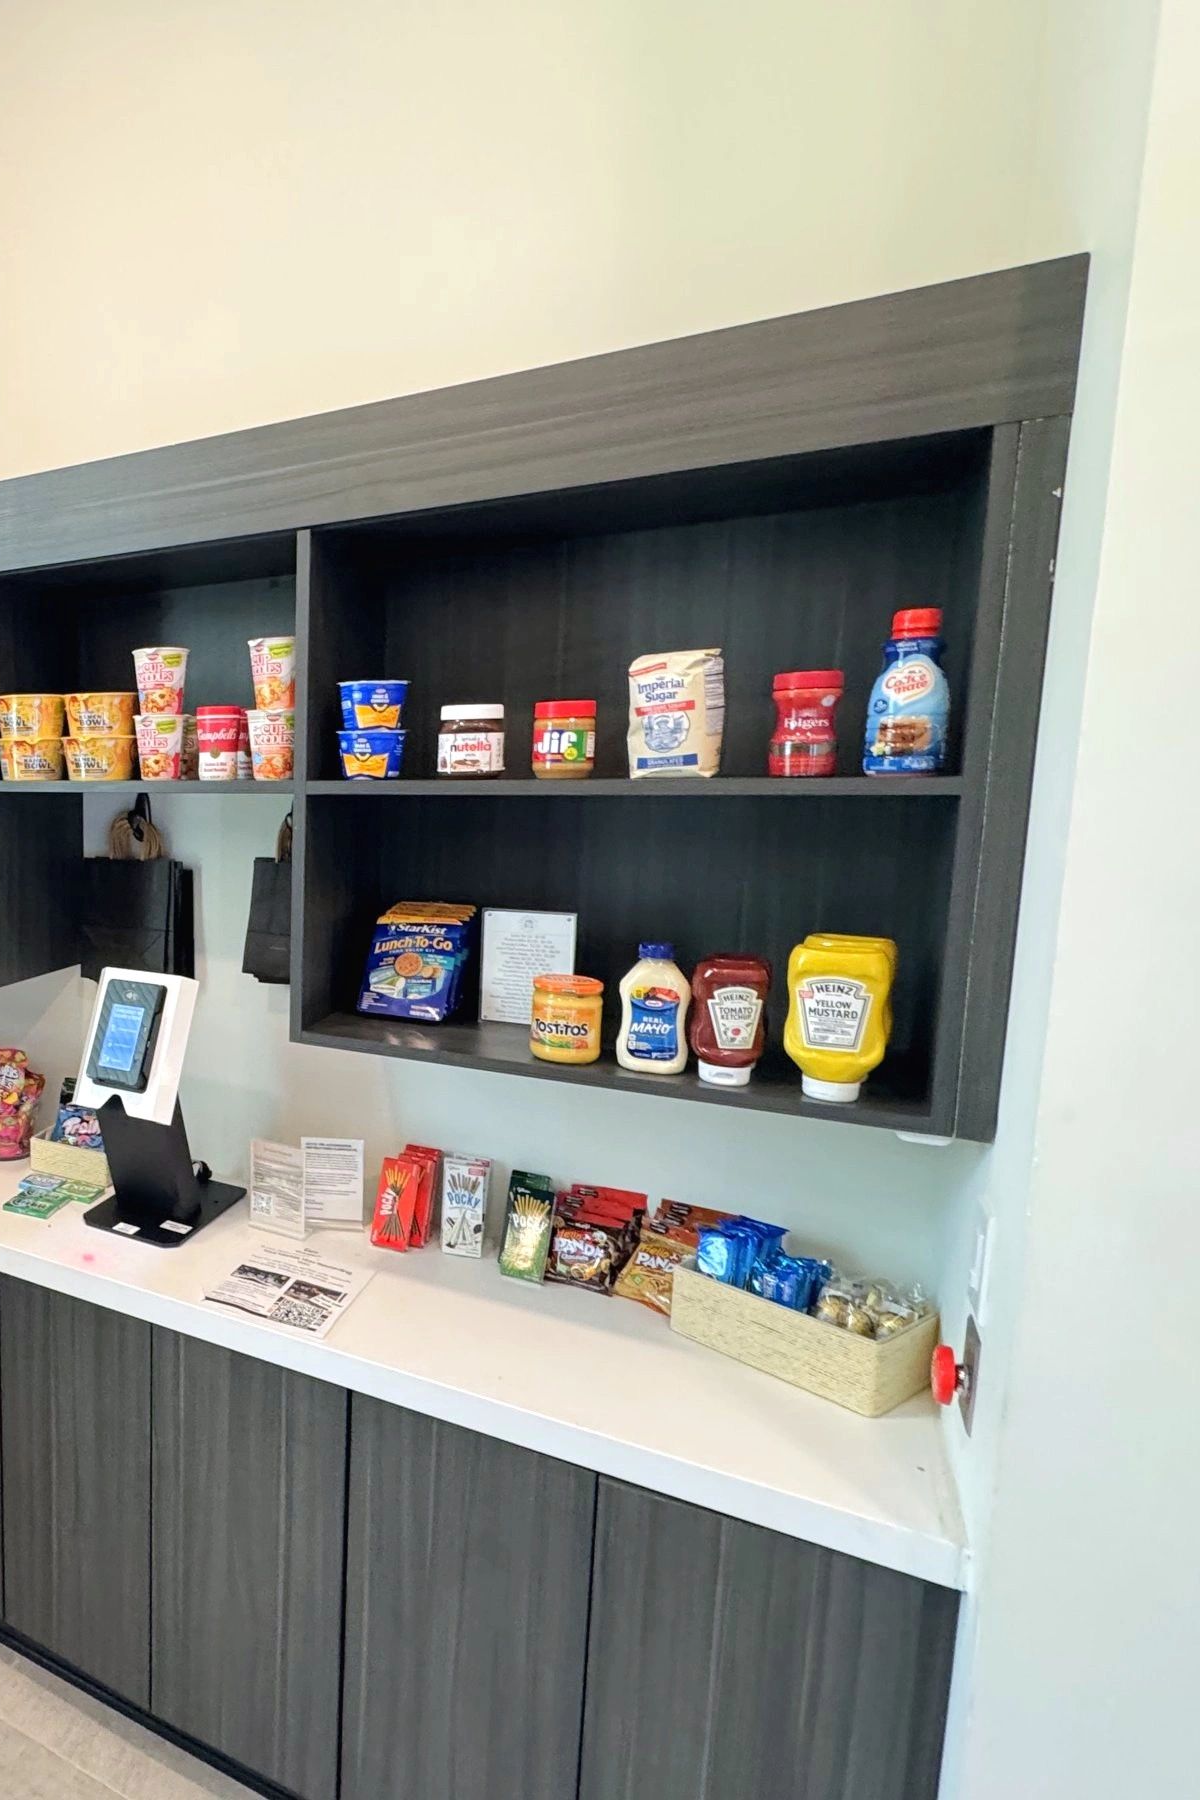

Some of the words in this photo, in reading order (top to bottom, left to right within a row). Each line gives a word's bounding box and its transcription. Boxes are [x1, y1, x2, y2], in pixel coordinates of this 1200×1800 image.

[142, 663, 164, 672] CUP
[637, 679, 684, 694] Imperial
[645, 691, 678, 703] Sugar
[262, 724, 287, 734] CUP
[784, 717, 829, 729] Folgers
[450, 741, 491, 752] nutella
[397, 923, 448, 935] StarKist
[815, 984, 854, 996] HEINZ
[723, 993, 750, 1002] HEINZ
[719, 1006, 753, 1014] TOMATO
[815, 999, 852, 1009] YELLOW
[808, 1007, 858, 1019] MUSTARD
[630, 1022, 674, 1035] MAYO
[380, 1187, 398, 1215] POCKY
[447, 1191, 481, 1209] POCKY
[555, 1237, 604, 1259] PANDA
